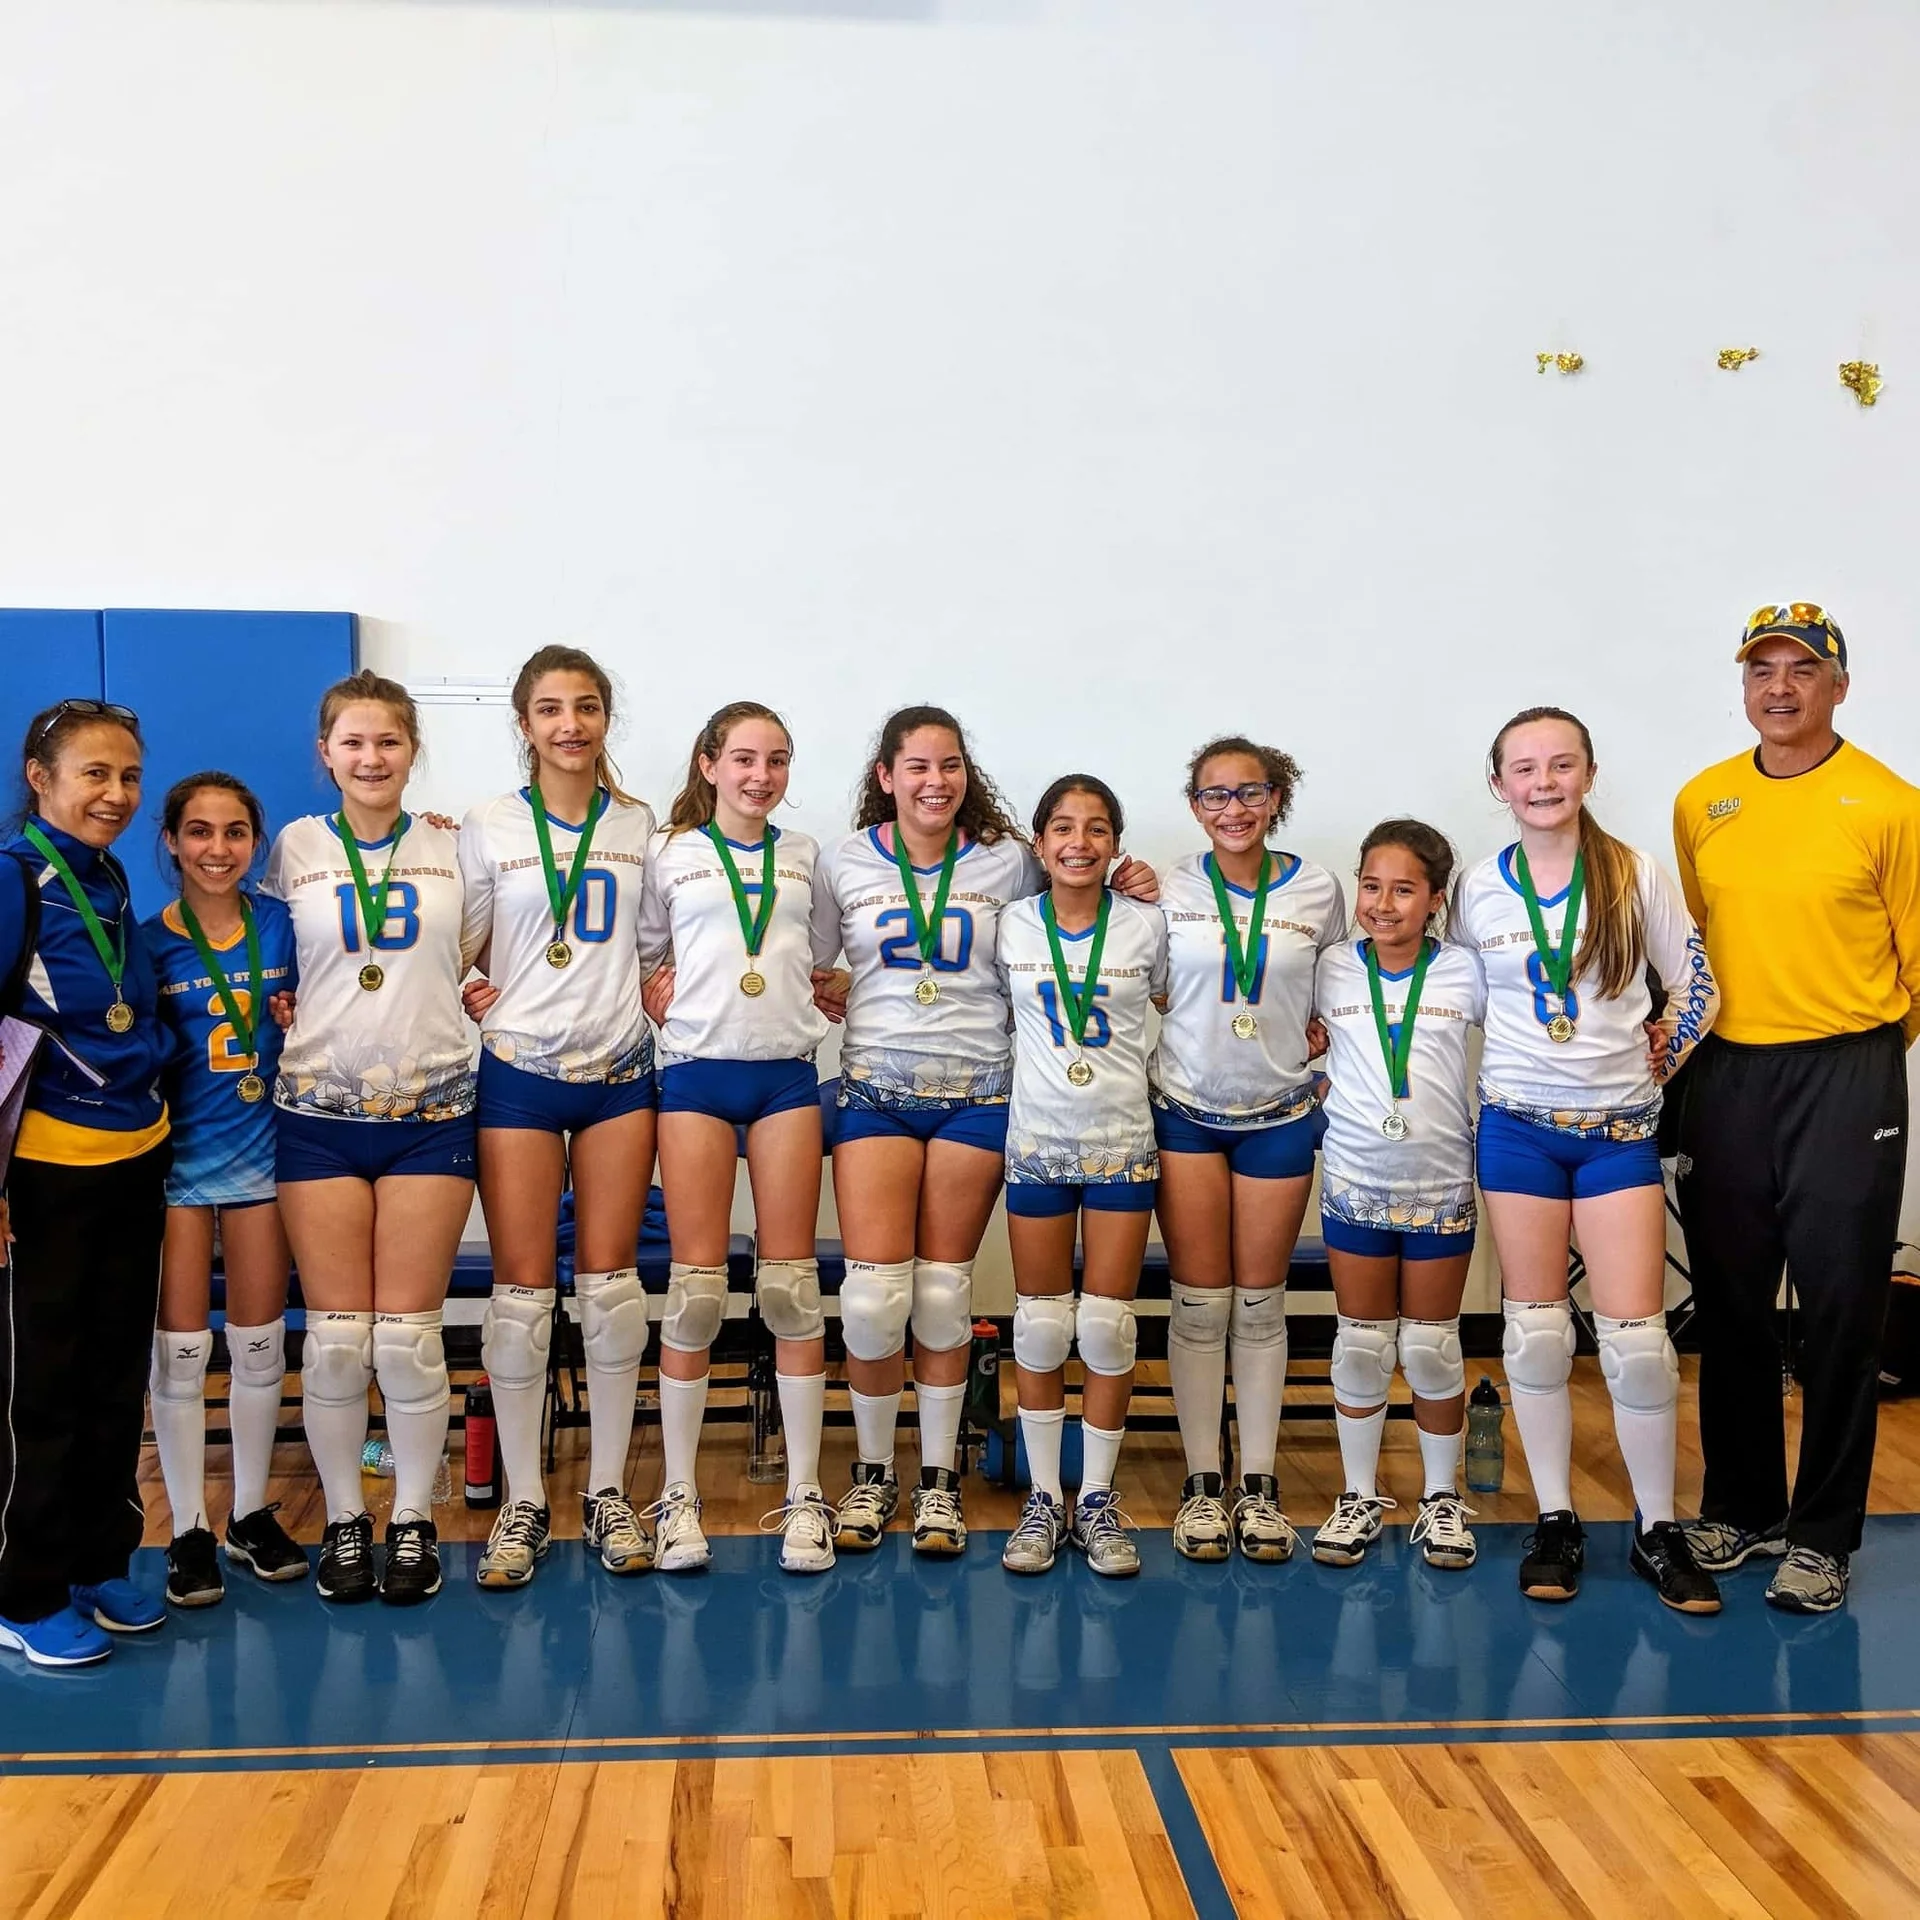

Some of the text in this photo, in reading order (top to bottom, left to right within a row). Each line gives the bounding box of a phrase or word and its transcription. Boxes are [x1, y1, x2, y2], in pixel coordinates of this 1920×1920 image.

[499, 856, 541, 873] RAISE
[715, 868, 756, 878] YUR
[292, 871, 328, 890] RAISE
[333, 868, 376, 879] YOR
[889, 892, 926, 904] YOR
[334, 881, 421, 955] 18
[875, 907, 974, 973] 20
[1480, 935, 1505, 949] AISE
[1010, 963, 1036, 972] AISE
[1040, 963, 1074, 973] YOR
[194, 973, 236, 989] YOR
[1526, 948, 1580, 1026] 8
[1037, 980, 1113, 1048] 15
[207, 988, 260, 1073] 2
